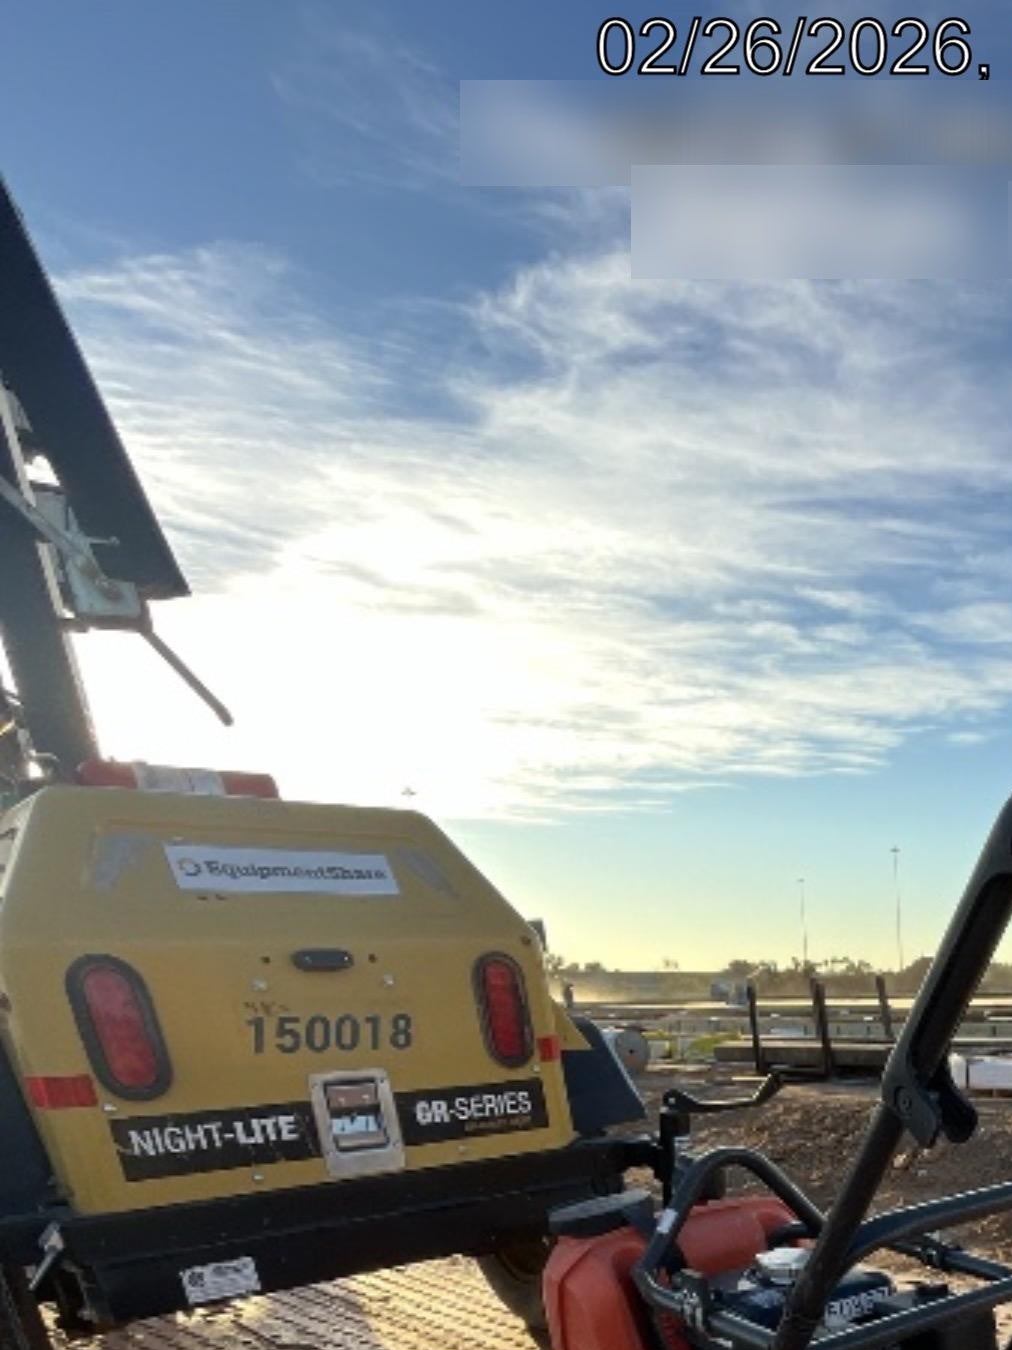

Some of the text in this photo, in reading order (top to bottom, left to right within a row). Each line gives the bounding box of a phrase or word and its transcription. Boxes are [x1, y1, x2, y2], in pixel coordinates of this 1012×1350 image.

[246, 1013, 412, 1054] 150018
[416, 1091, 531, 1125] GR-SERIES
[128, 1115, 299, 1156] NIGHT-LITE
